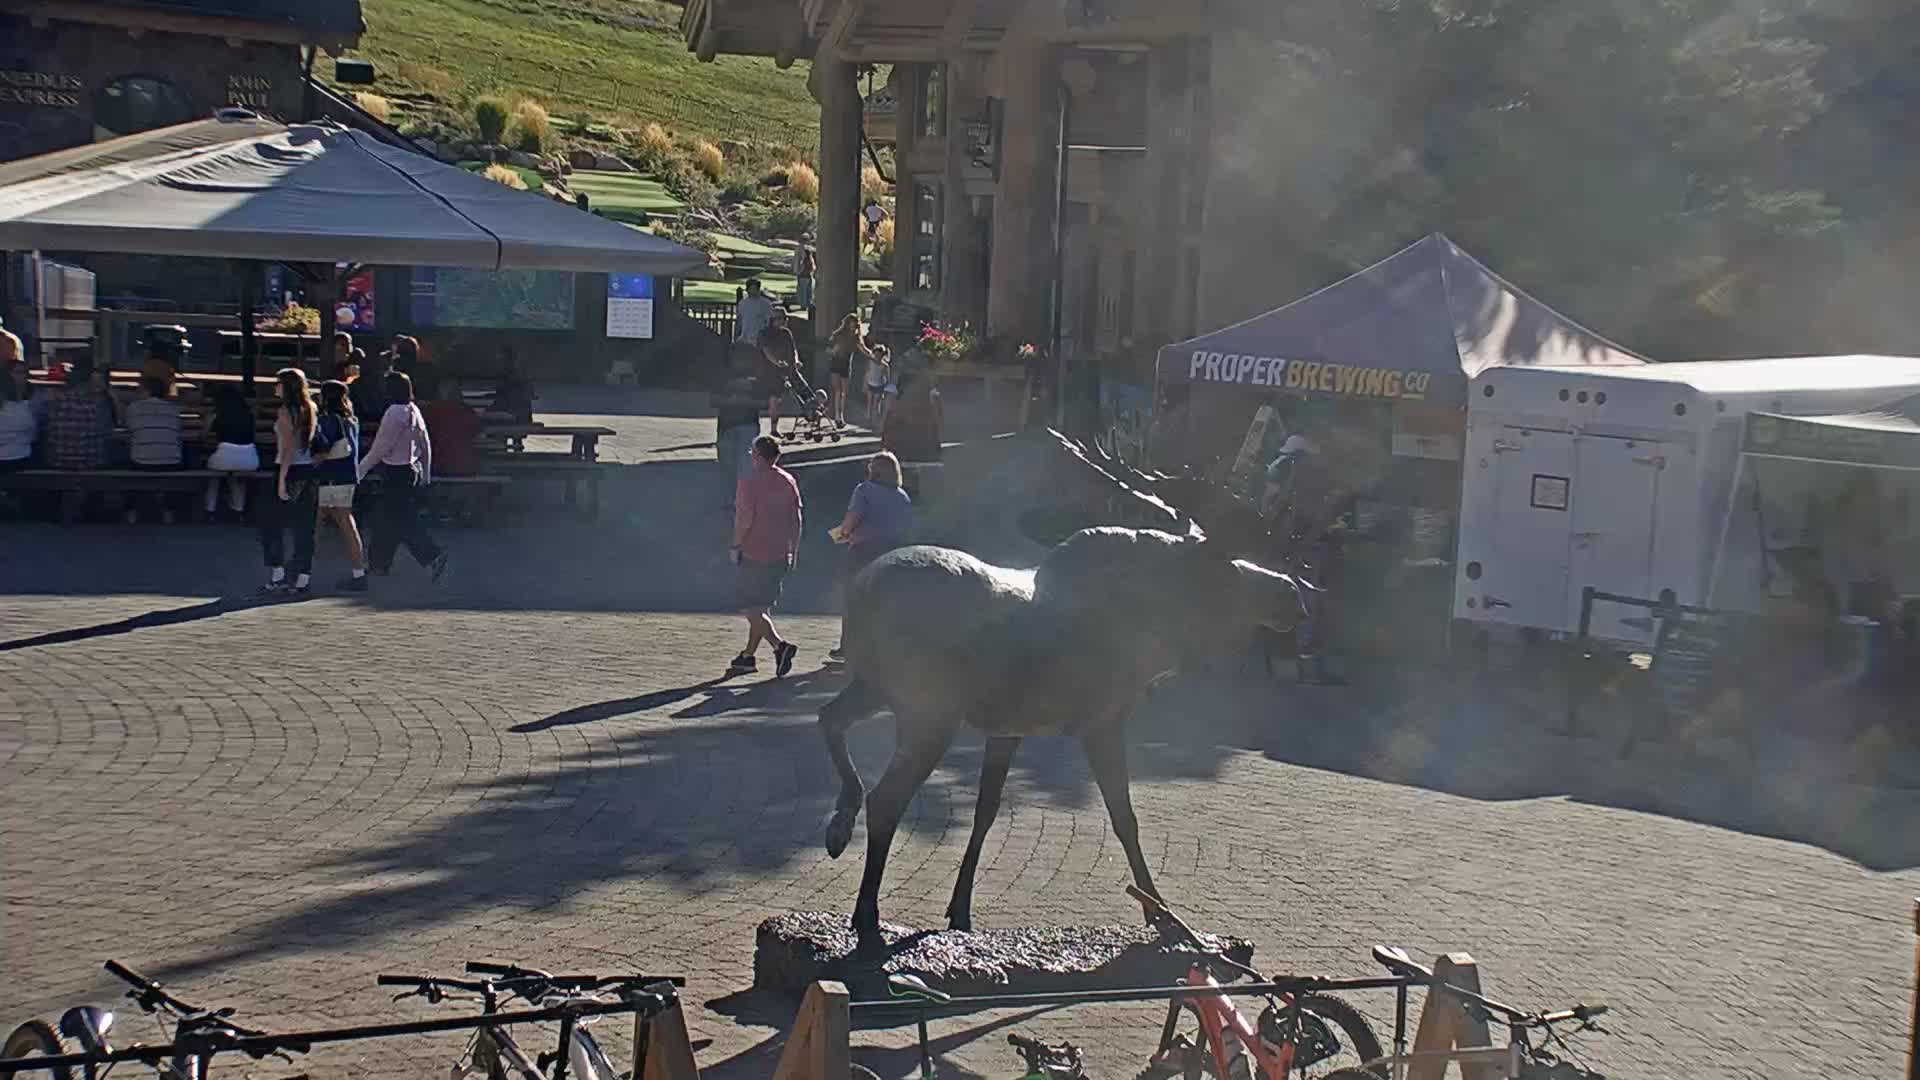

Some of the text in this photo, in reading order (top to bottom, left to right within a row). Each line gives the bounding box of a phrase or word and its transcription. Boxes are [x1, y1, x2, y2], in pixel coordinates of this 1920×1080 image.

[228, 91, 267, 106] PAUL
[1189, 350, 1287, 386] PROPER
[1286, 359, 1402, 397] BREWING
